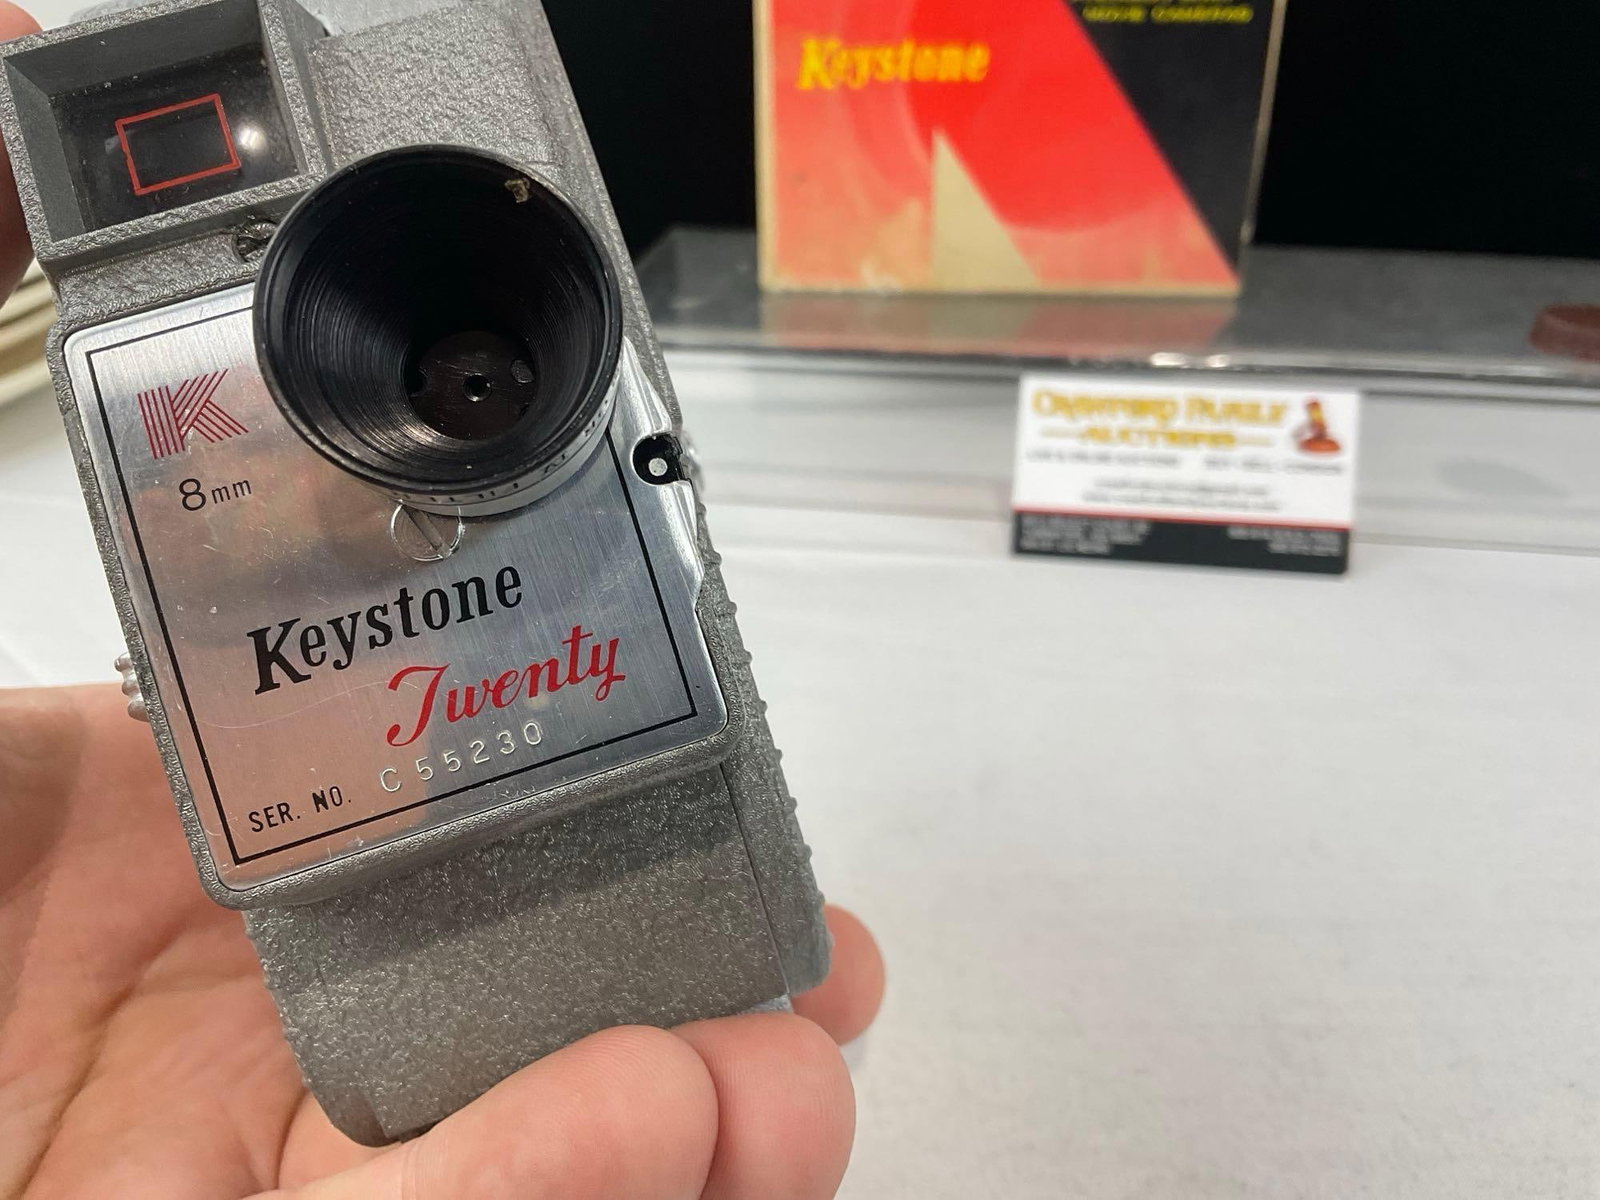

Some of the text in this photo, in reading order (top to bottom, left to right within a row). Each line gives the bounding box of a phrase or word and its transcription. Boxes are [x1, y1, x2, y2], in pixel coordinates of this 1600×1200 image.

[797, 37, 990, 91] Keystone
[179, 477, 252, 512] 8mm
[247, 564, 523, 696] Keystone
[386, 625, 627, 747] Twenty
[248, 803, 301, 833] SER.
[312, 786, 352, 812] NO.
